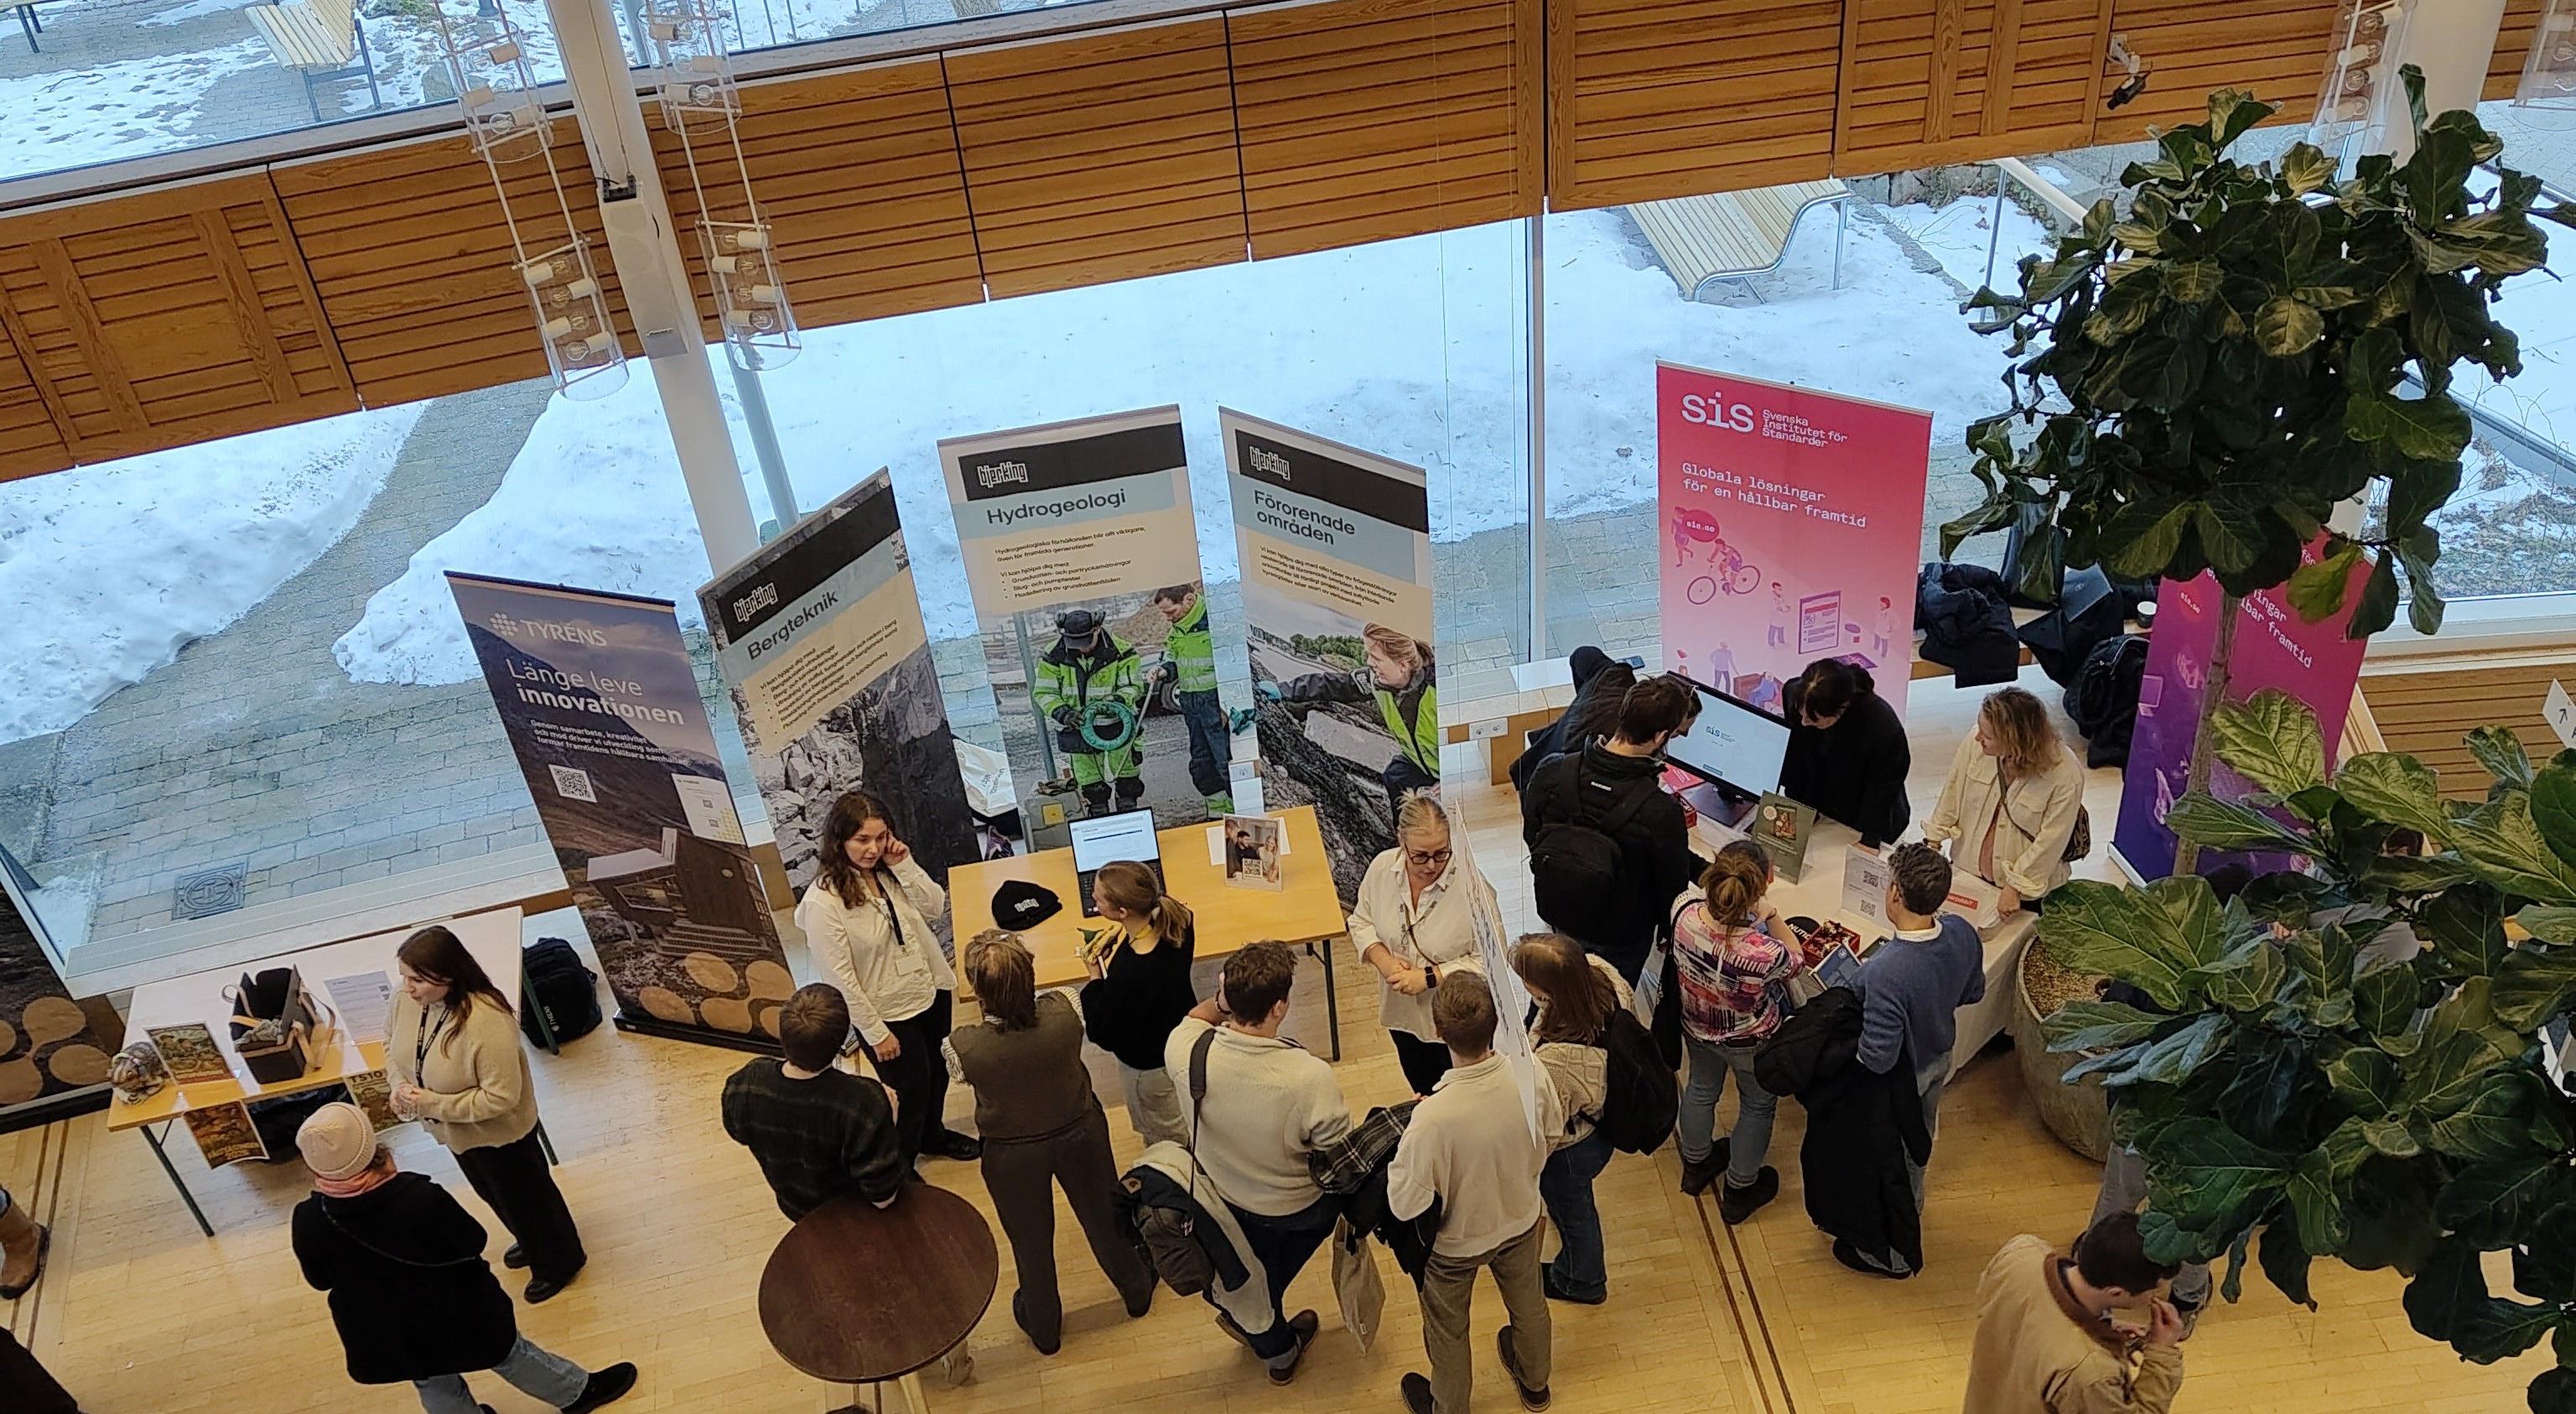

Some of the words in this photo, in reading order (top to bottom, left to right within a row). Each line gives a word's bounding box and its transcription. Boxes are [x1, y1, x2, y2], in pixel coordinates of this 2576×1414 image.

[1762, 409, 1809, 426] Svenska
[1763, 418, 1826, 439] Institutet
[1829, 430, 1847, 443] för
[1762, 428, 1828, 447] Standarder
[1681, 462, 1742, 485] Globala
[1748, 476, 1826, 502] lösningar
[987, 488, 1126, 525] Hydrogeologi
[1254, 489, 1356, 535] Förorenade
[1682, 479, 1708, 493] för
[1714, 488, 1732, 498] en
[1737, 490, 1798, 512] hållbar
[1805, 504, 1867, 528] framtid
[1257, 511, 1334, 546] områden
[519, 619, 608, 647] TYRÉNS
[747, 590, 839, 660] Bergteknik
[2267, 621, 2313, 669] framtid
[506, 658, 585, 691] Länge
[589, 670, 643, 696] leve
[516, 683, 685, 725] innovationen
